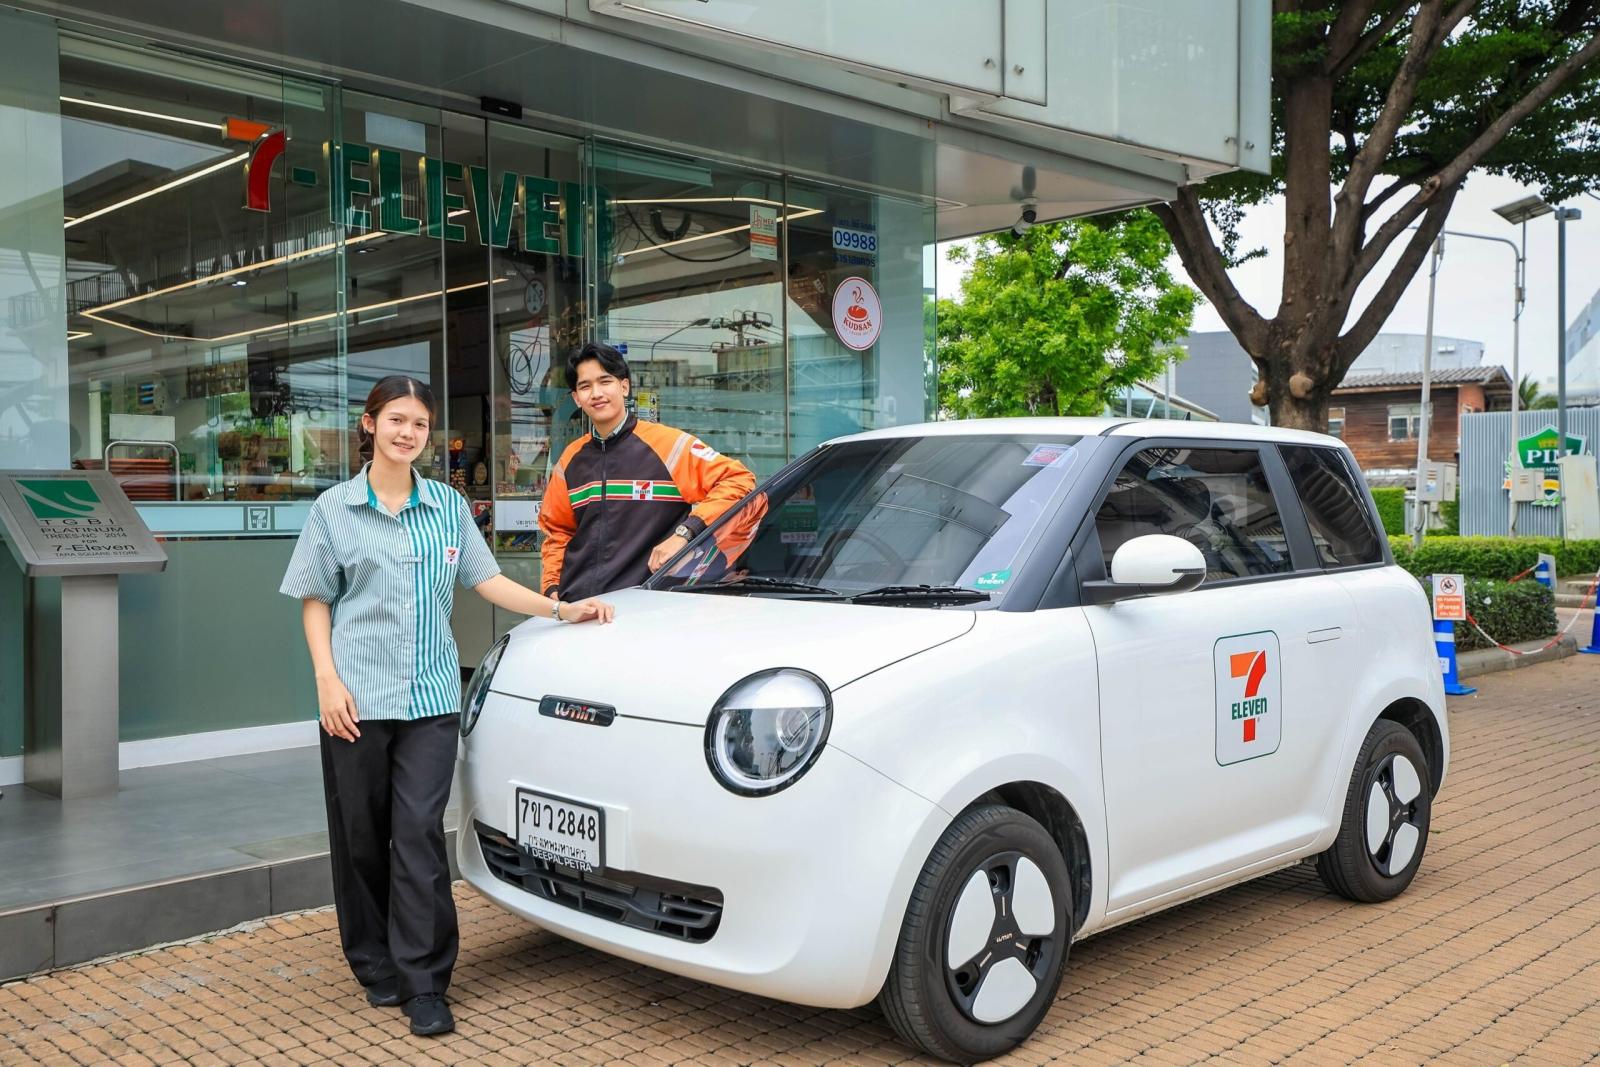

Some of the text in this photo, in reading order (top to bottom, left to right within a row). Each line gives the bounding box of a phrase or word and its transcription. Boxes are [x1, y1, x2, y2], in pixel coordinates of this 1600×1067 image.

[834, 230, 876, 251] 09988
[843, 316, 872, 331] KUDSAN
[51, 544, 135, 552] 7-Eleven
[557, 808, 597, 842] 2848
[528, 834, 587, 860] กรงเทพมหานคร
[531, 847, 593, 873] DEEPAL PETRA
